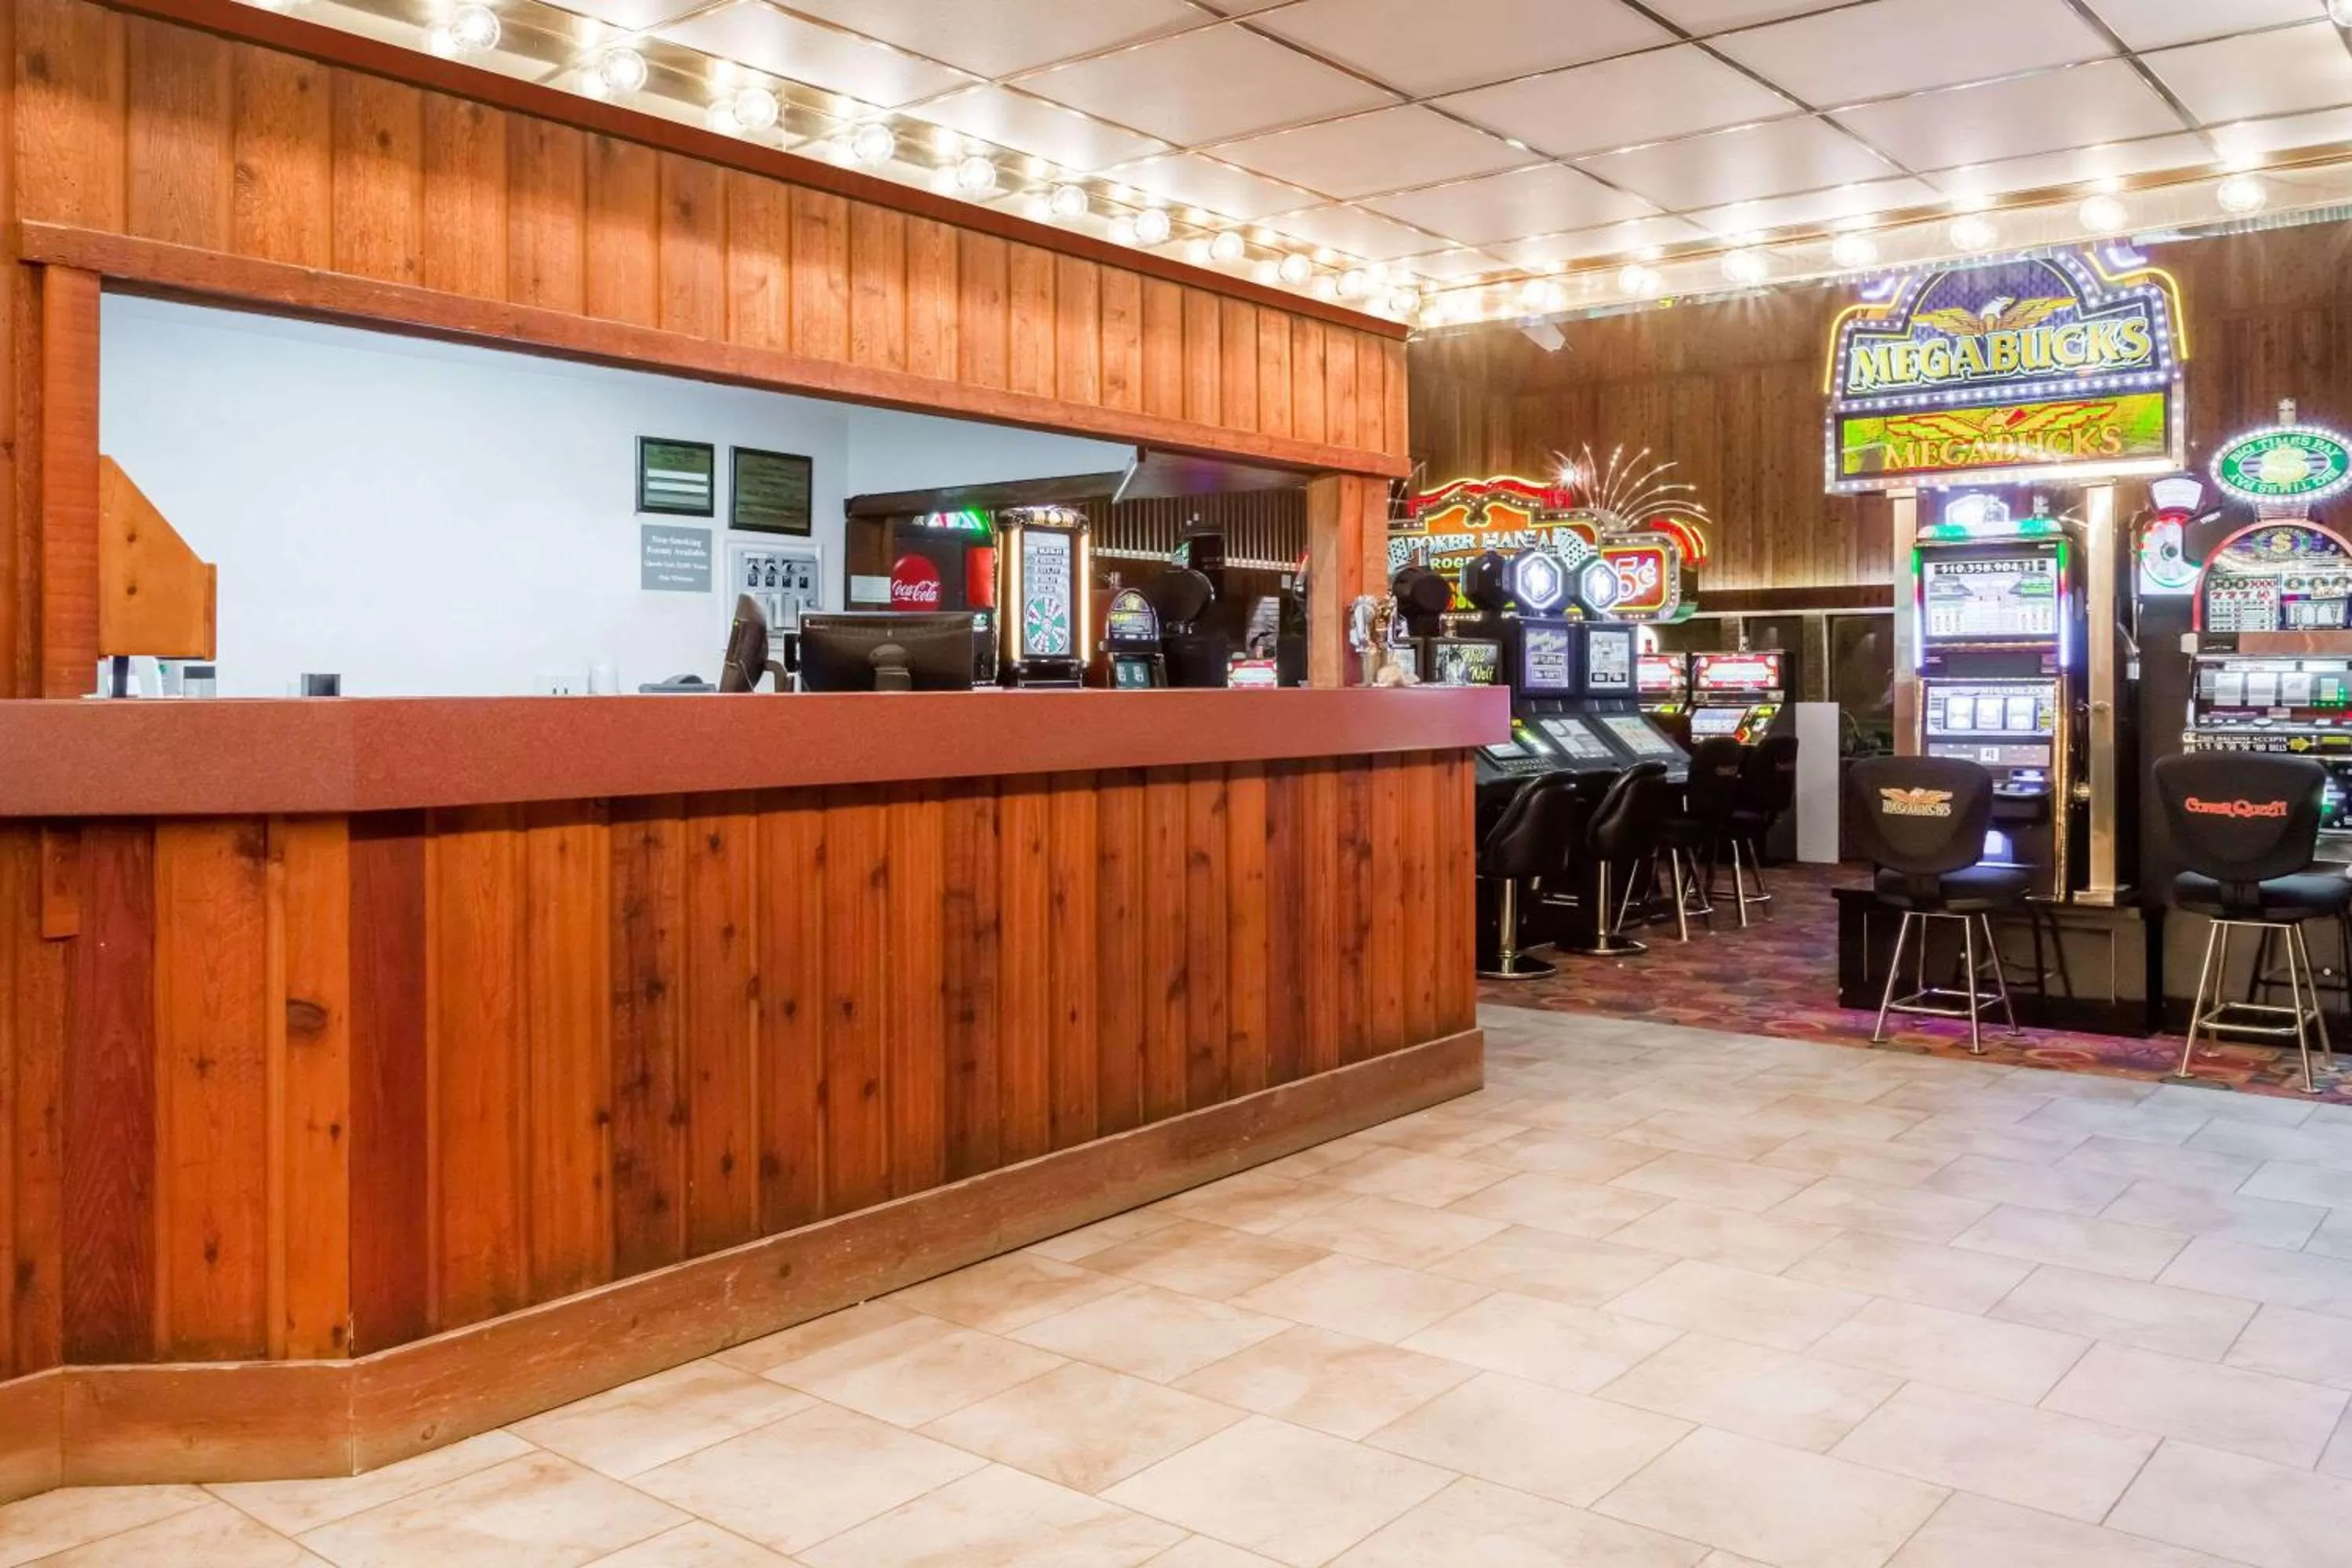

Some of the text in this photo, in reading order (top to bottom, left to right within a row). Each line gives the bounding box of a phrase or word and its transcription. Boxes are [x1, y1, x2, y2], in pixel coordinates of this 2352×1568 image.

[1849, 317, 2151, 391] MEGABUCKS
[1883, 426, 2122, 470] MEGABUCKS
[1408, 534, 1476, 554] POKER
